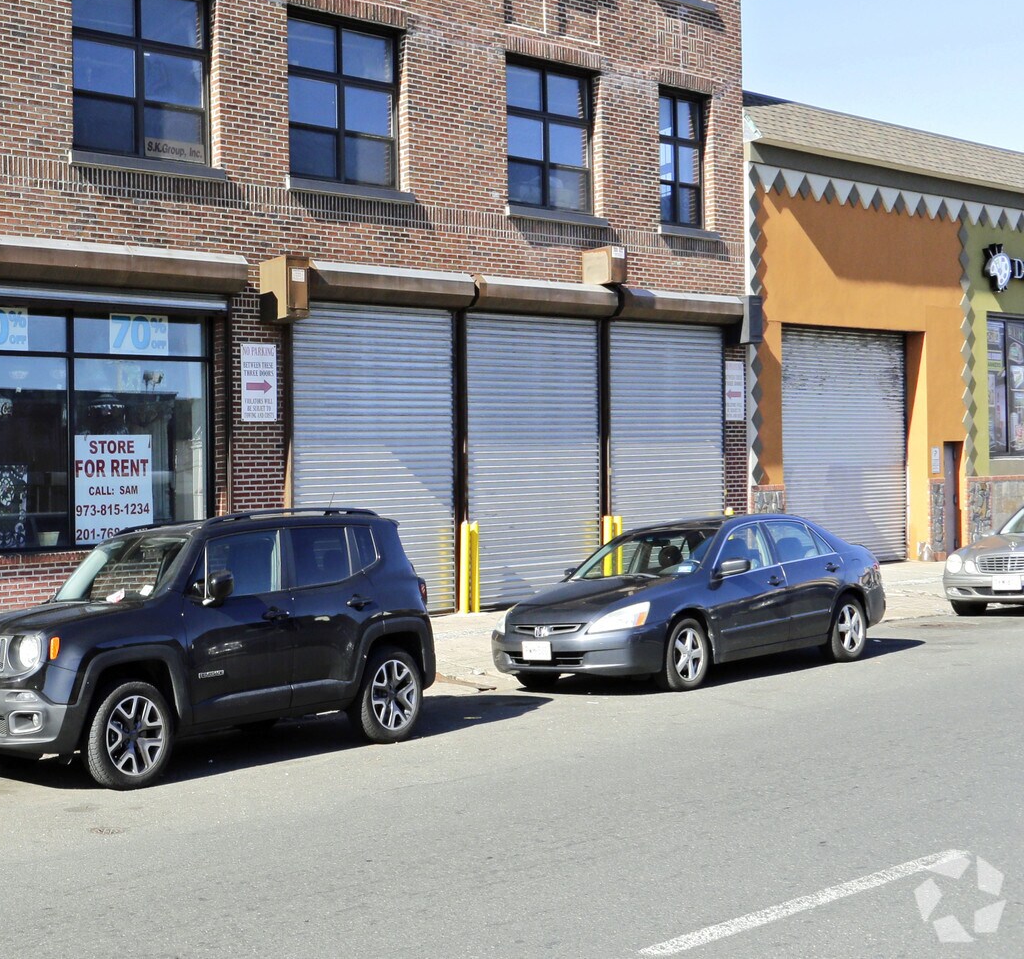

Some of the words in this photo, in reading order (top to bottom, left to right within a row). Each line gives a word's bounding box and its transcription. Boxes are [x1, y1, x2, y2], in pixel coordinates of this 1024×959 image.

[189, 147, 202, 158] Inc.
[9, 334, 26, 345] OFF
[151, 340, 166, 350] OFF
[243, 346, 250, 355] NO
[251, 347, 274, 356] PARKING
[89, 440, 135, 454] STORE
[75, 459, 106, 478] FOR
[111, 459, 149, 477] RENT
[88, 486, 115, 496] CALL:
[119, 485, 138, 494] SAM
[76, 503, 150, 517] 973-815-1234
